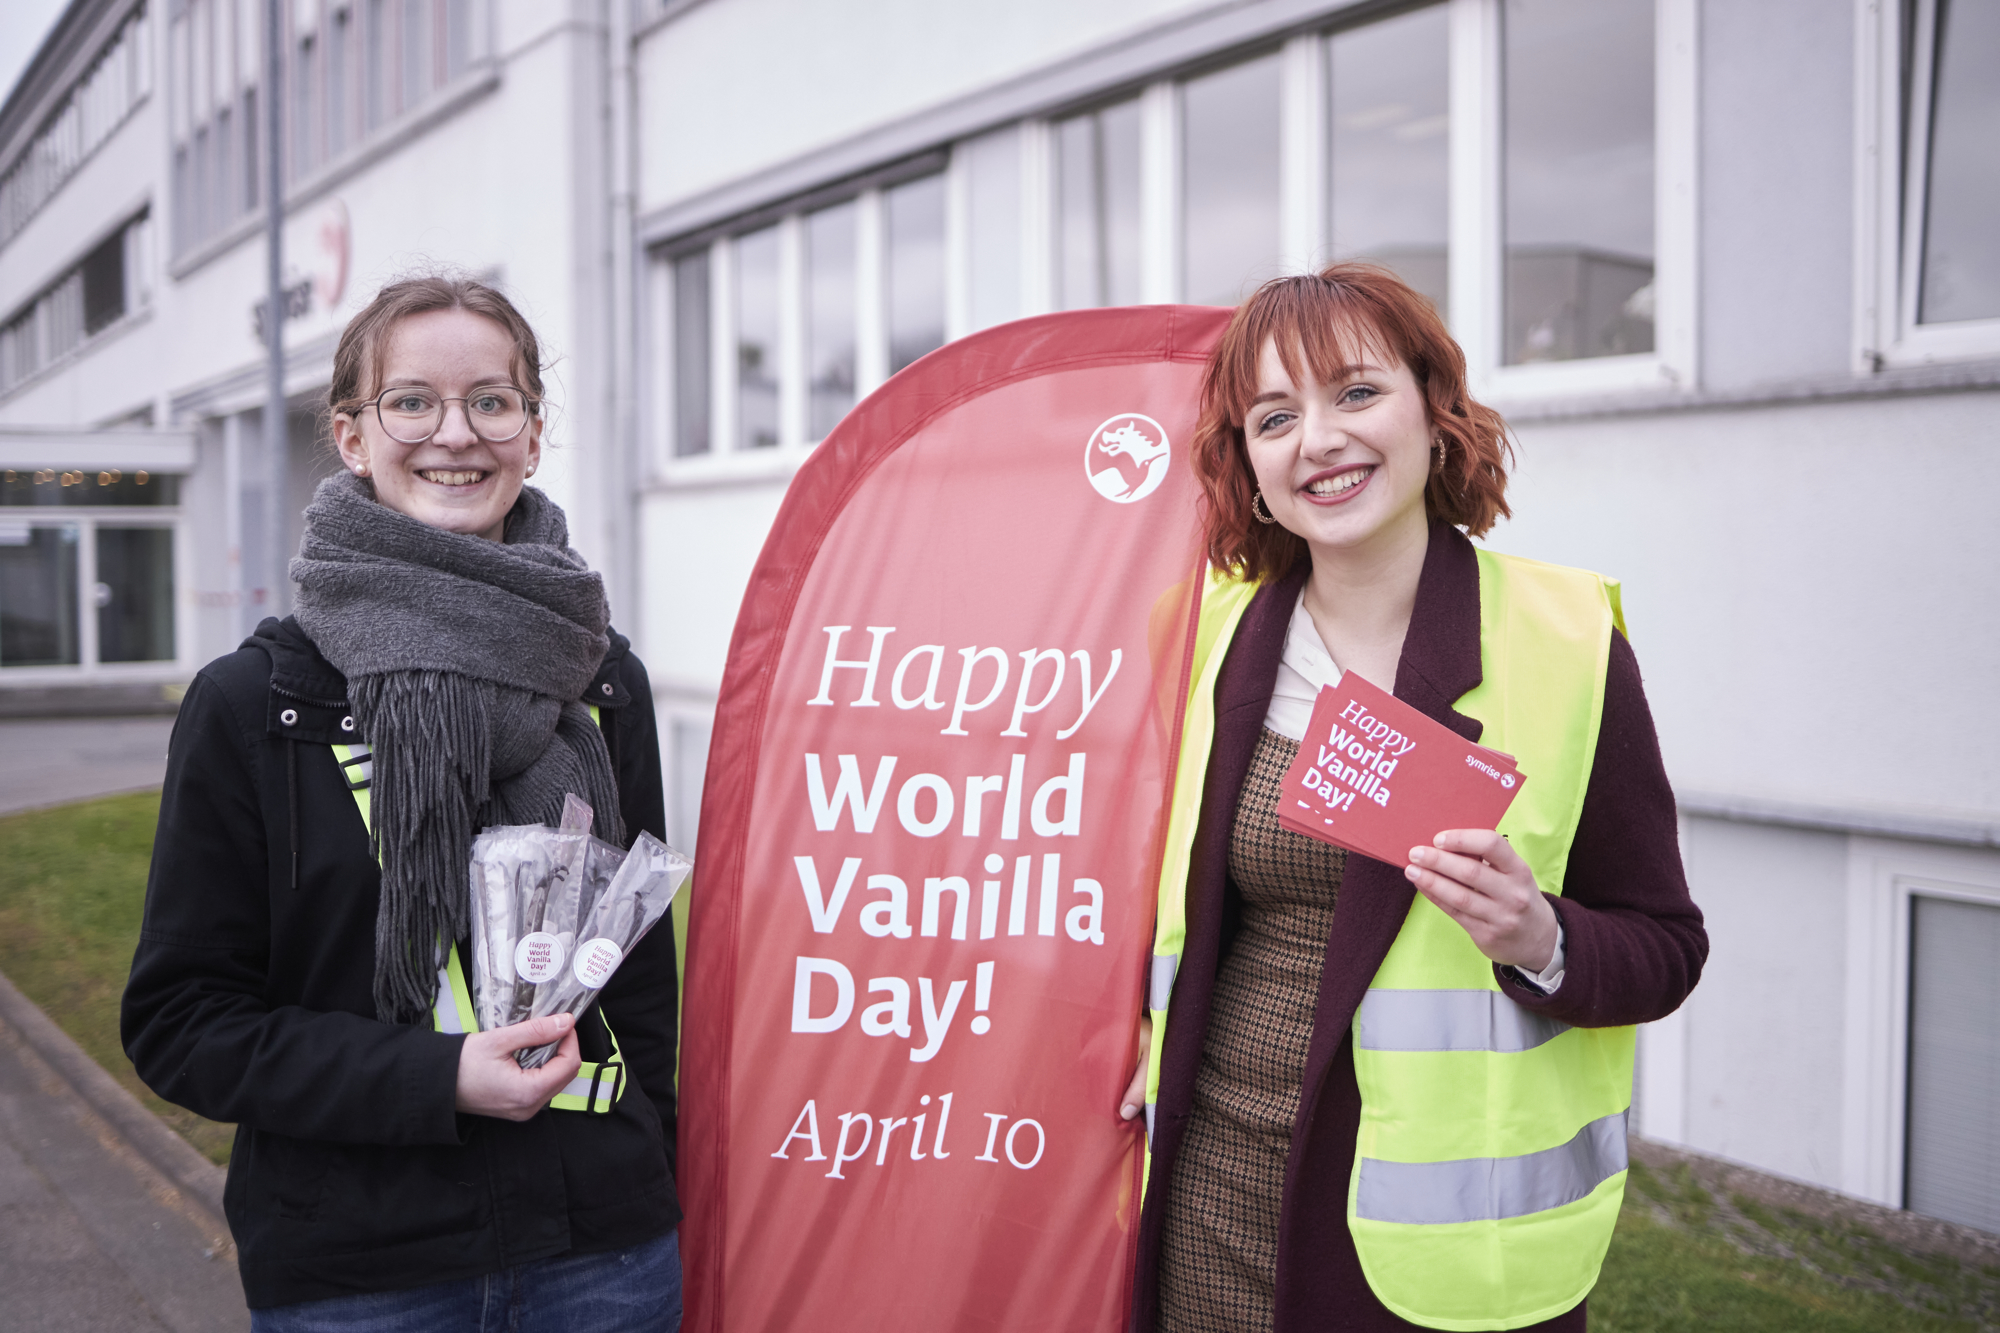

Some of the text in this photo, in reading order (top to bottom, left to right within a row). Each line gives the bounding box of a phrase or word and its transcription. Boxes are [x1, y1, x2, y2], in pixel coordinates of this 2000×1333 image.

[807, 625, 1123, 740] Happy
[1328, 722, 1399, 780] World
[1338, 698, 1417, 757] Happy
[1301, 765, 1356, 812] Day!
[1316, 743, 1391, 808] Vanilla
[1465, 754, 1501, 780] symrise
[804, 752, 1086, 840] World
[793, 853, 1105, 946] Vanilla
[528, 941, 553, 950] Happy
[529, 949, 551, 957] World
[530, 963, 547, 971] Day!
[587, 957, 608, 973] Vanilla
[592, 952, 611, 967] World
[594, 945, 616, 960] Happy
[586, 964, 602, 977] Day!
[791, 955, 995, 1063] Day!
[771, 1092, 1046, 1180] April 10
